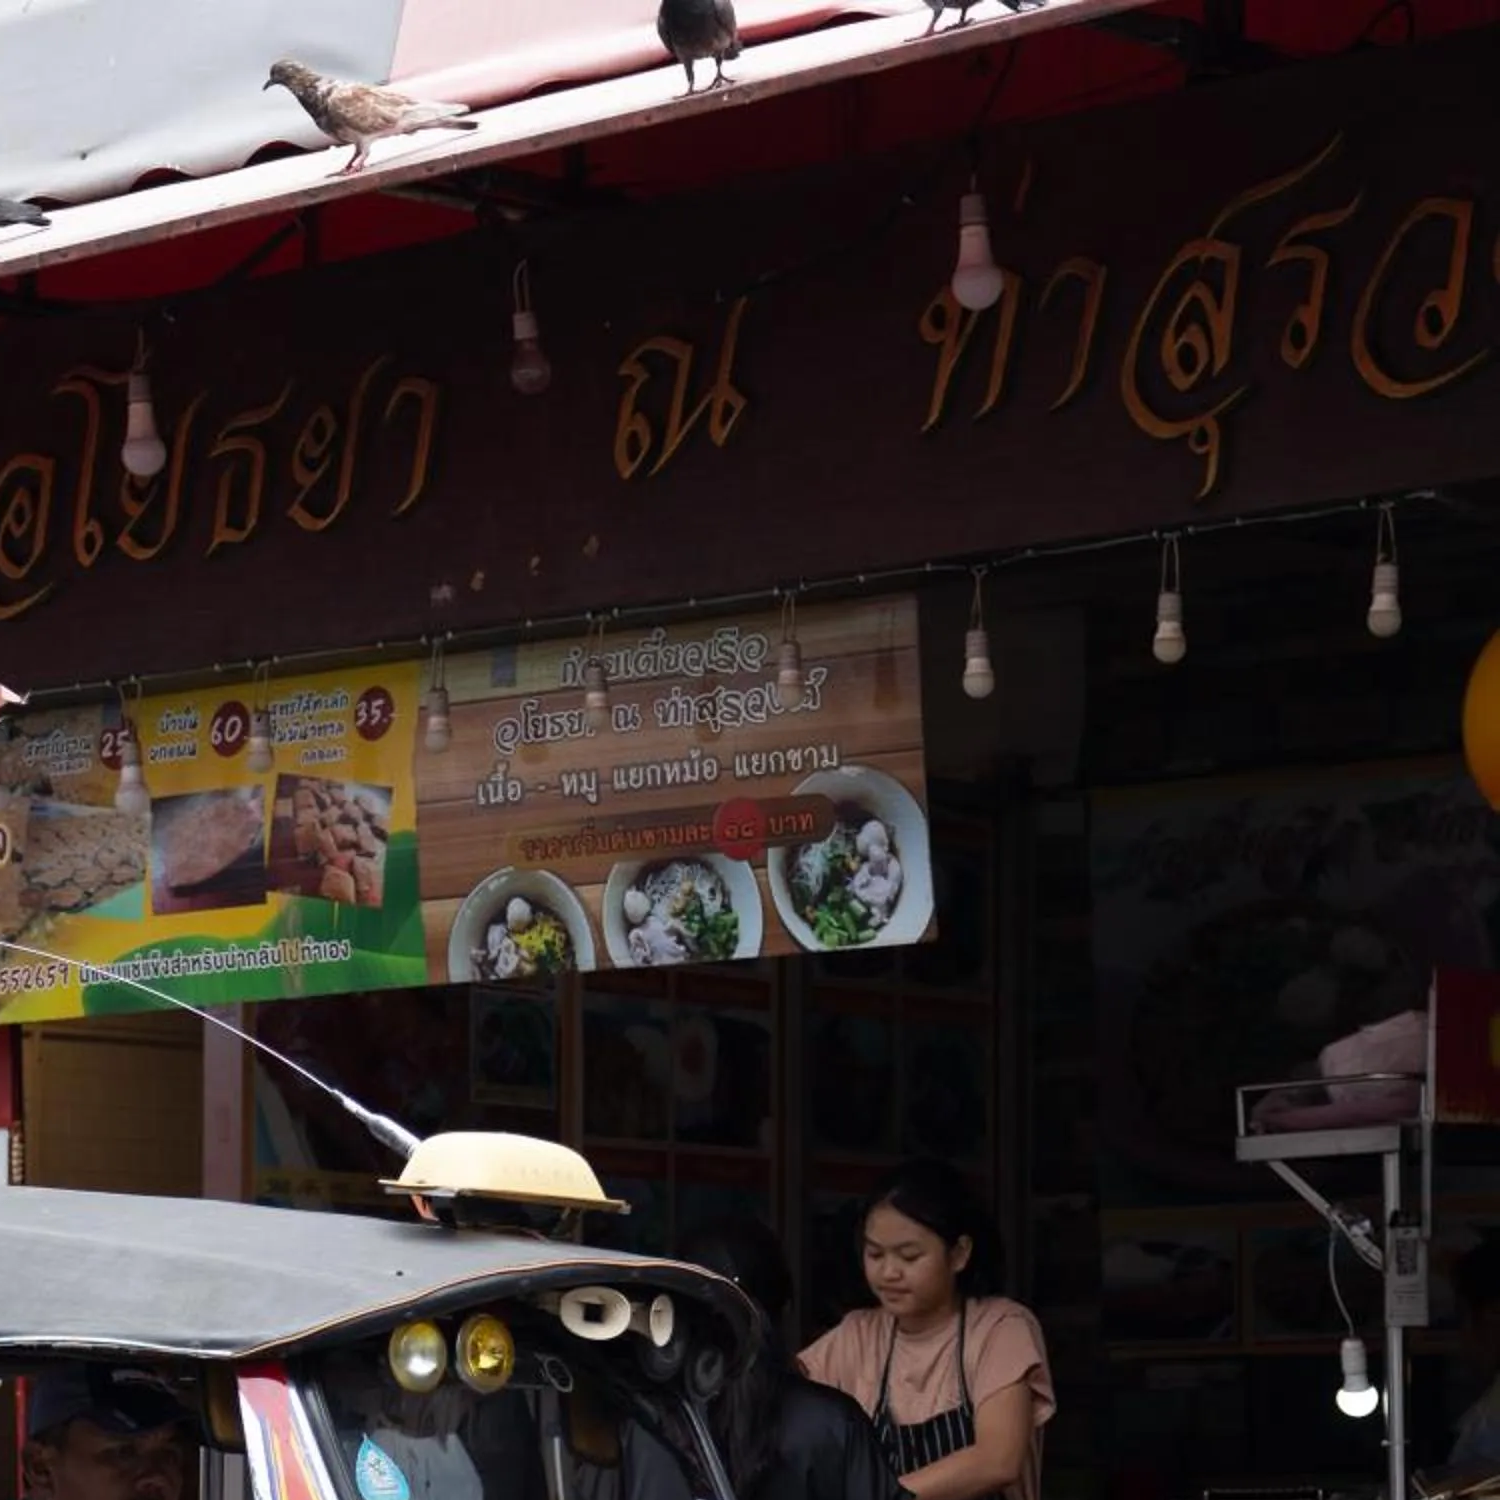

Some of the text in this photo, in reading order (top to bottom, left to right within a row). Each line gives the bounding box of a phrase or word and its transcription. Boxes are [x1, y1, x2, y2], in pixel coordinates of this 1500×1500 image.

[612, 297, 750, 480] ณ
[476, 757, 522, 806] เนื้อ
[561, 770, 599, 804] หมู
[613, 751, 719, 792] แยกหม้อ
[734, 742, 839, 779] แยกชาม
